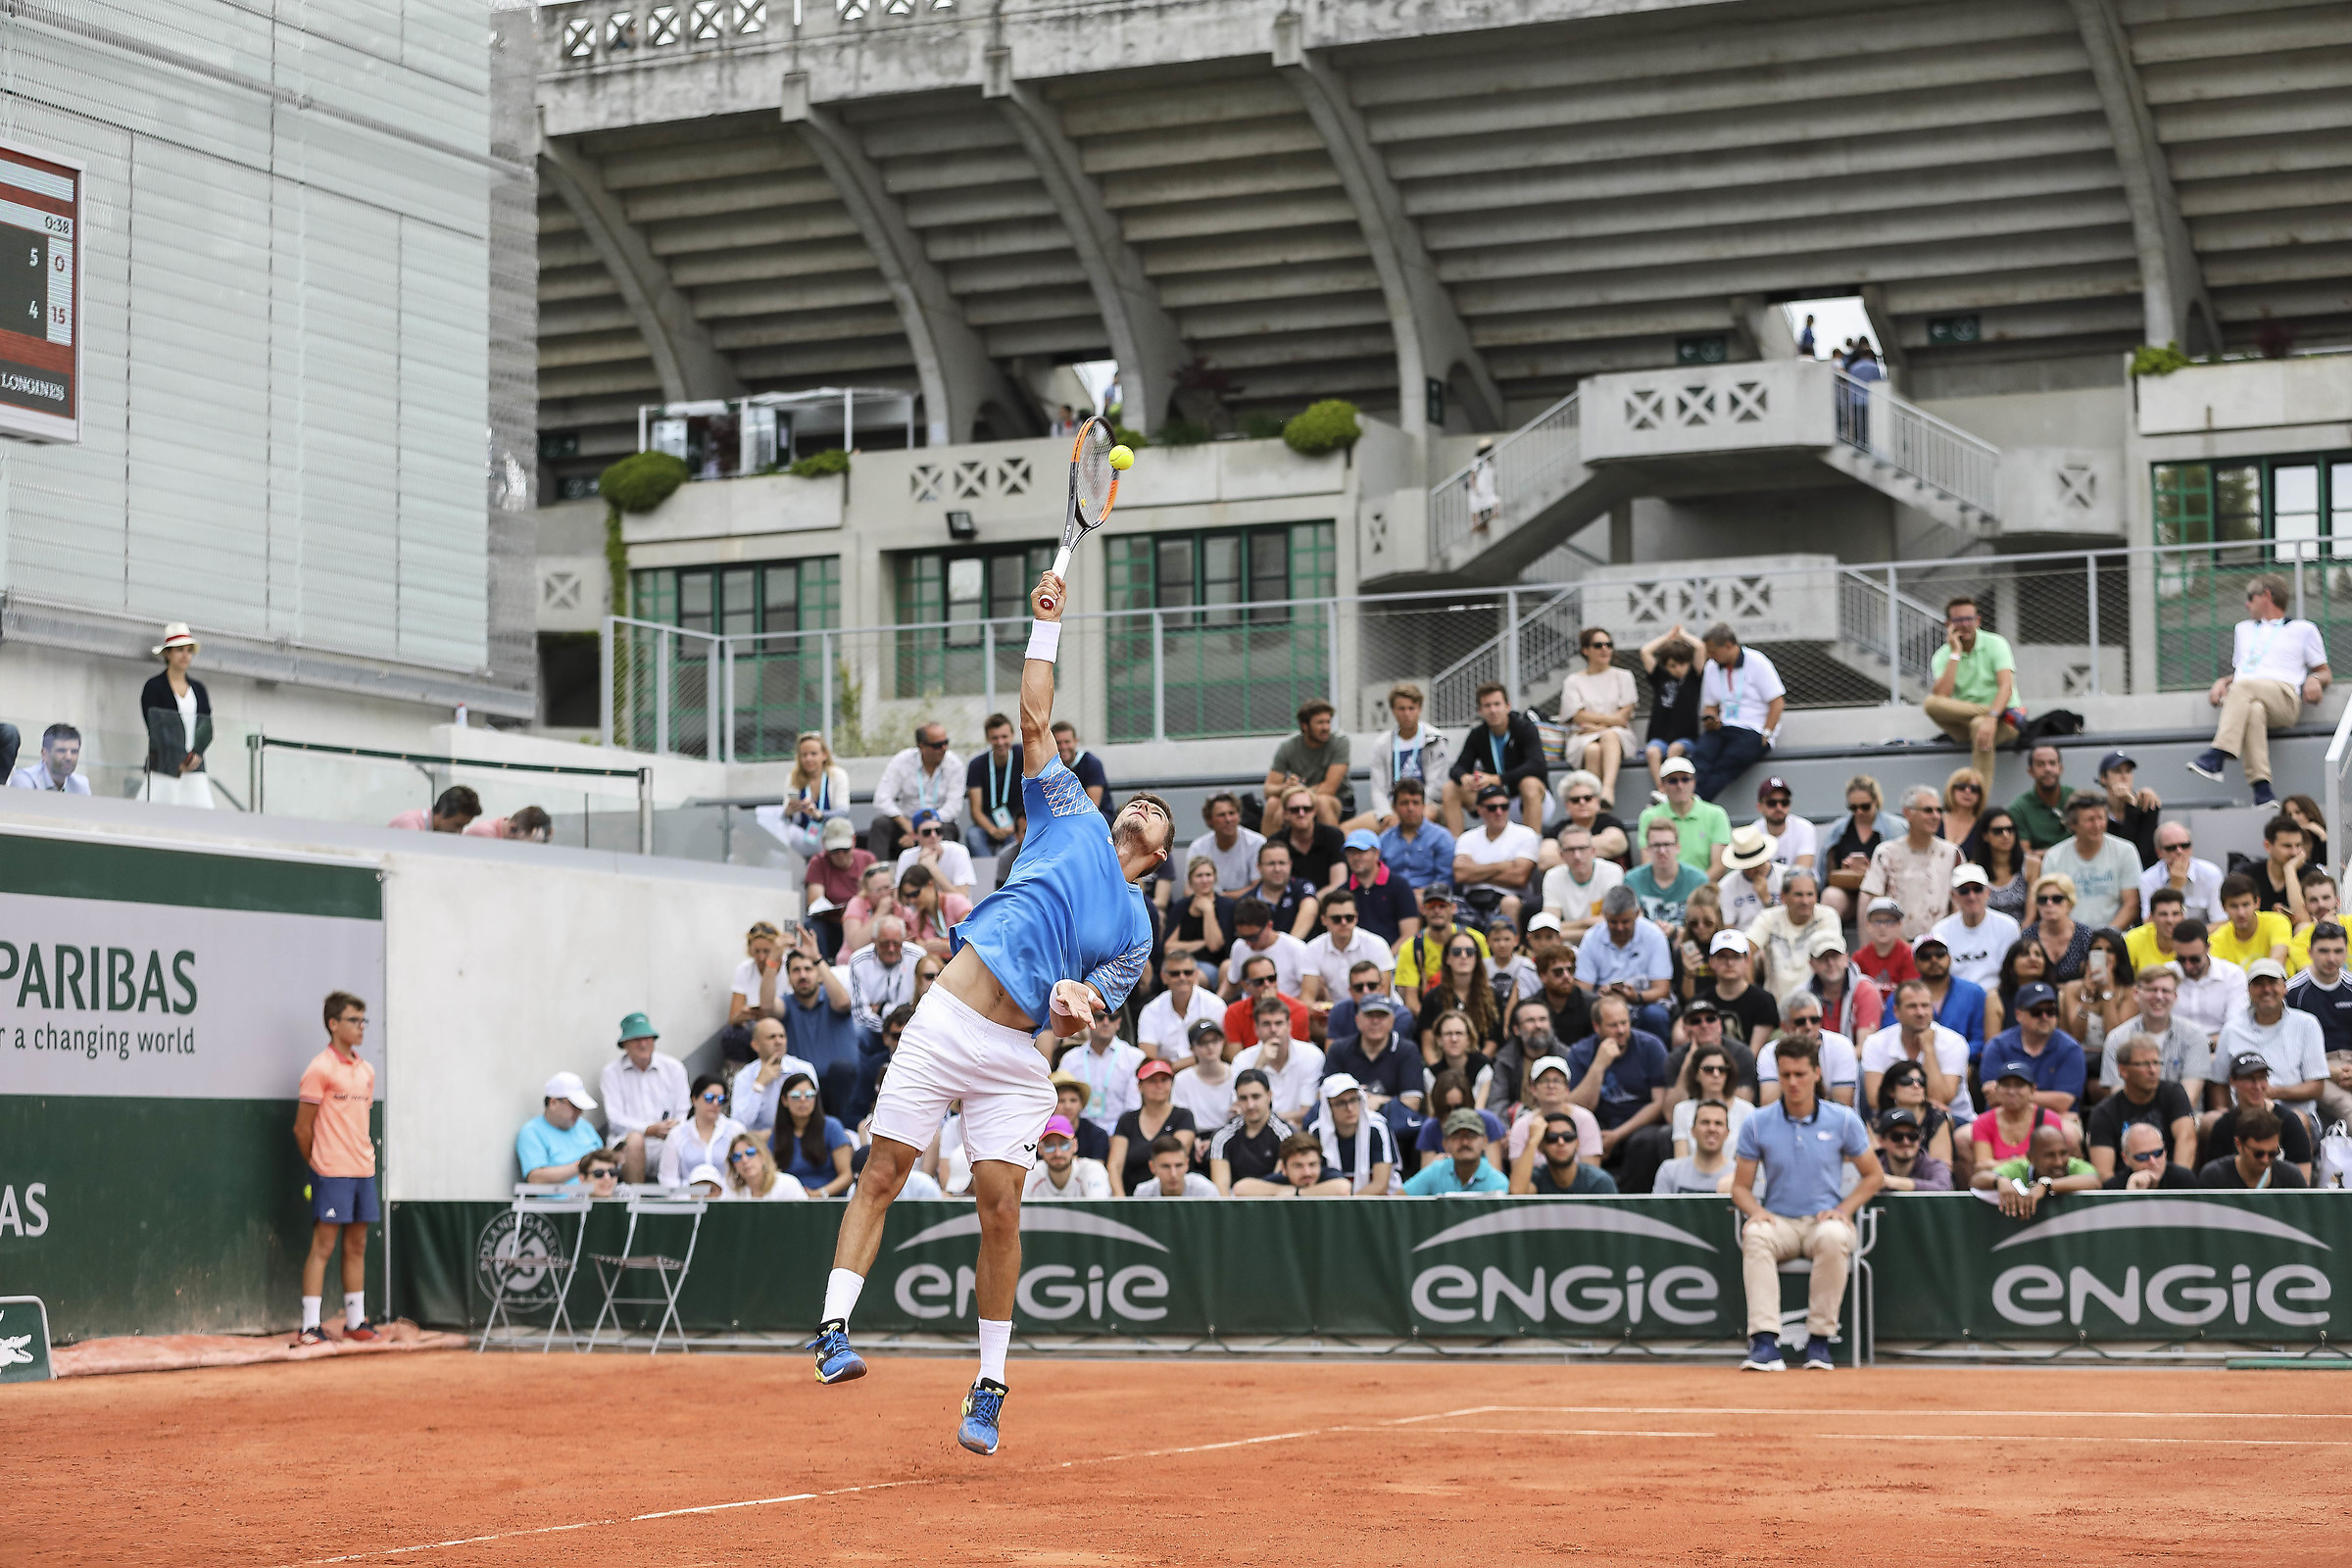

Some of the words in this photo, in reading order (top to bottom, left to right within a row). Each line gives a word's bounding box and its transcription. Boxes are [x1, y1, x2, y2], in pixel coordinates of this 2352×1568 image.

[28, 247, 38, 267] 5
[55, 255, 65, 272] 0
[28, 300, 39, 319] 4
[52, 306, 66, 324] 15
[1, 371, 65, 402] LONGINES
[0, 941, 197, 1014] PARIBAS
[15, 1028, 25, 1049] a
[34, 1021, 129, 1060] changing
[138, 1027, 195, 1054] world
[0, 1183, 49, 1237] AS
